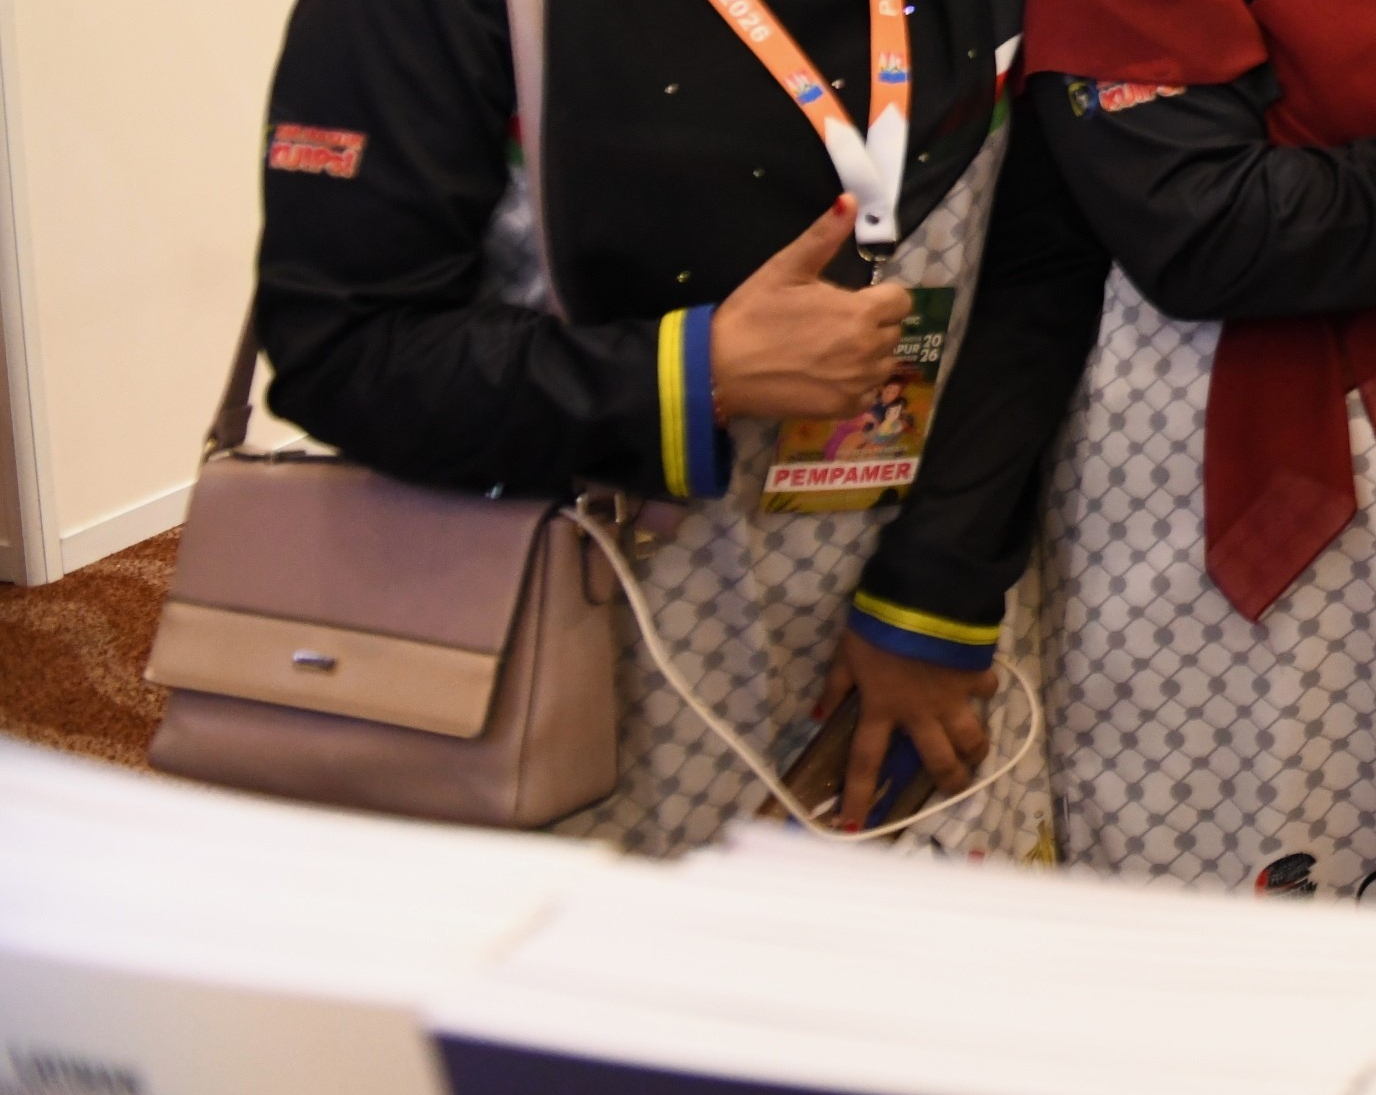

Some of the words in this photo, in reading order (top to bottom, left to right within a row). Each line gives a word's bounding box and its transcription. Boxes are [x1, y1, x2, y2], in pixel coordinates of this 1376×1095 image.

[923, 334, 943, 347] 20
[919, 349, 939, 363] 26
[773, 462, 912, 487] PEMPAMER
